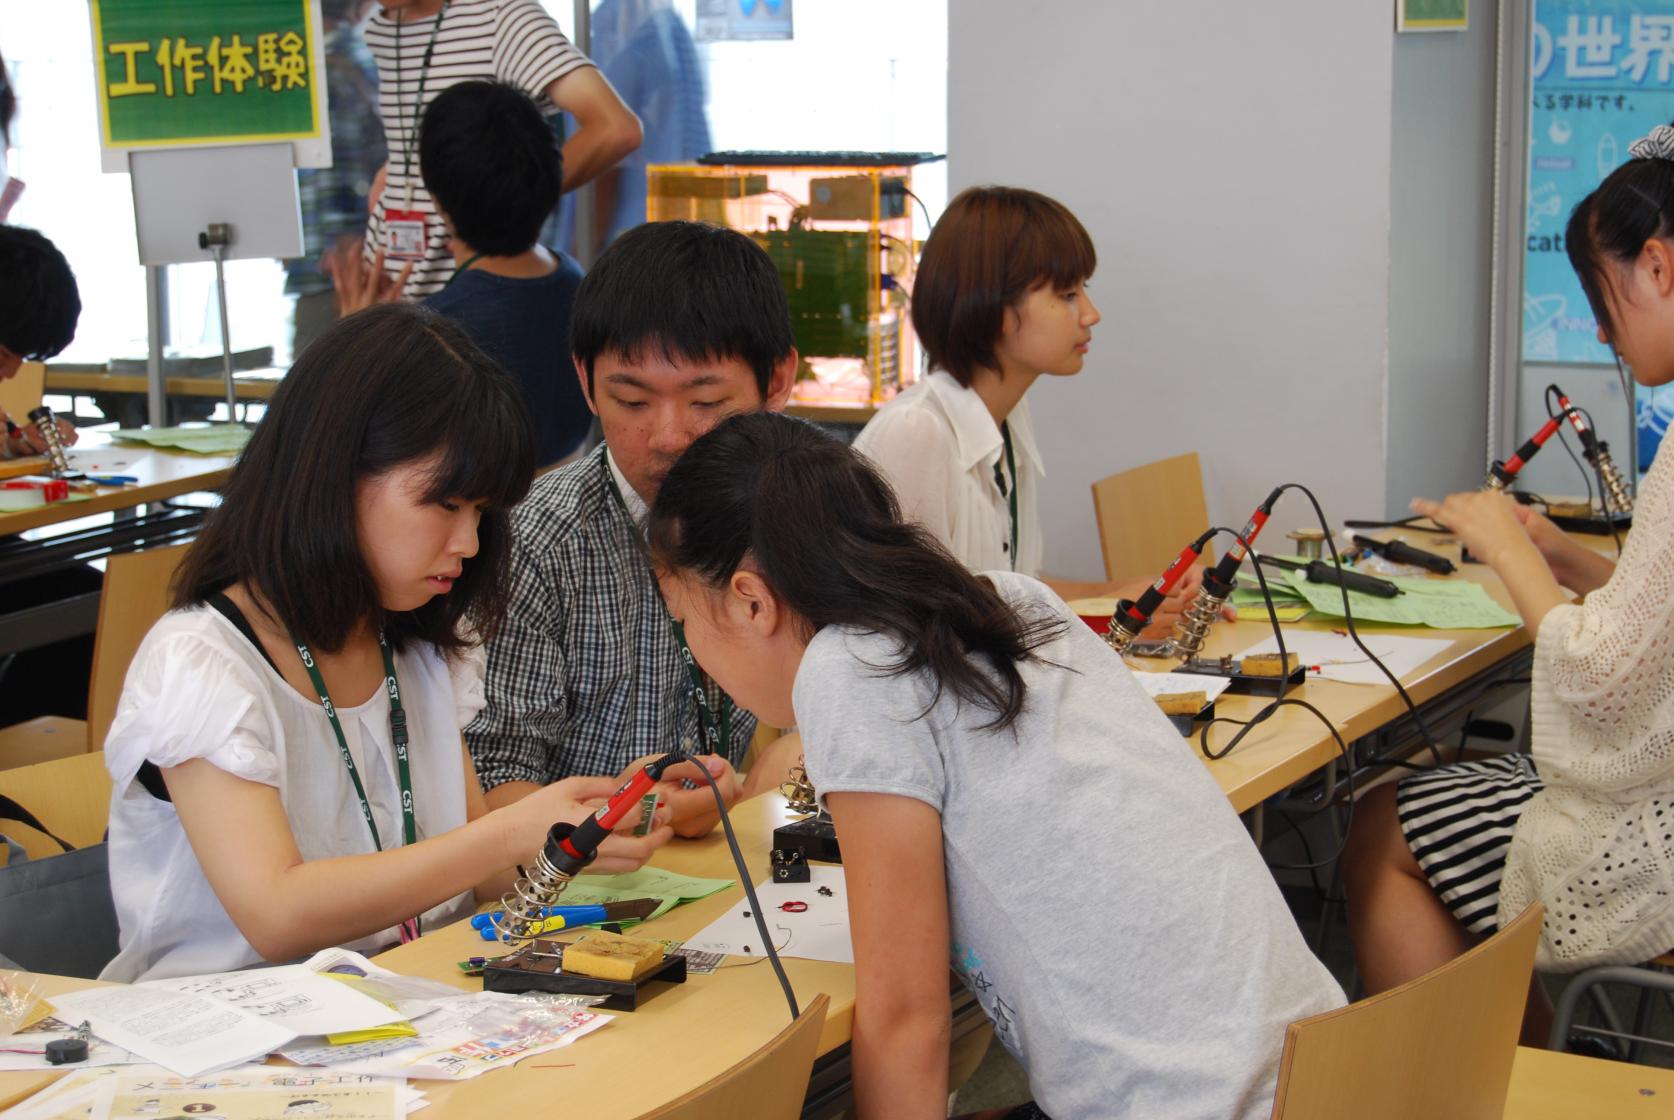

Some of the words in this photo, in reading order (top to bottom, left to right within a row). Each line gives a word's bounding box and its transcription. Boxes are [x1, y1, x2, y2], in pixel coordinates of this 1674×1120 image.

[107, 31, 307, 98] 工作体験
[297, 645, 314, 668] CST
[682, 646, 694, 665] CST
[387, 676, 399, 700] CST
[695, 688, 707, 708] CST
[320, 695, 334, 718] CST
[708, 727, 720, 744] CST
[340, 746, 353, 769] CST
[396, 743, 407, 761] ST
[402, 790, 414, 814] CST
